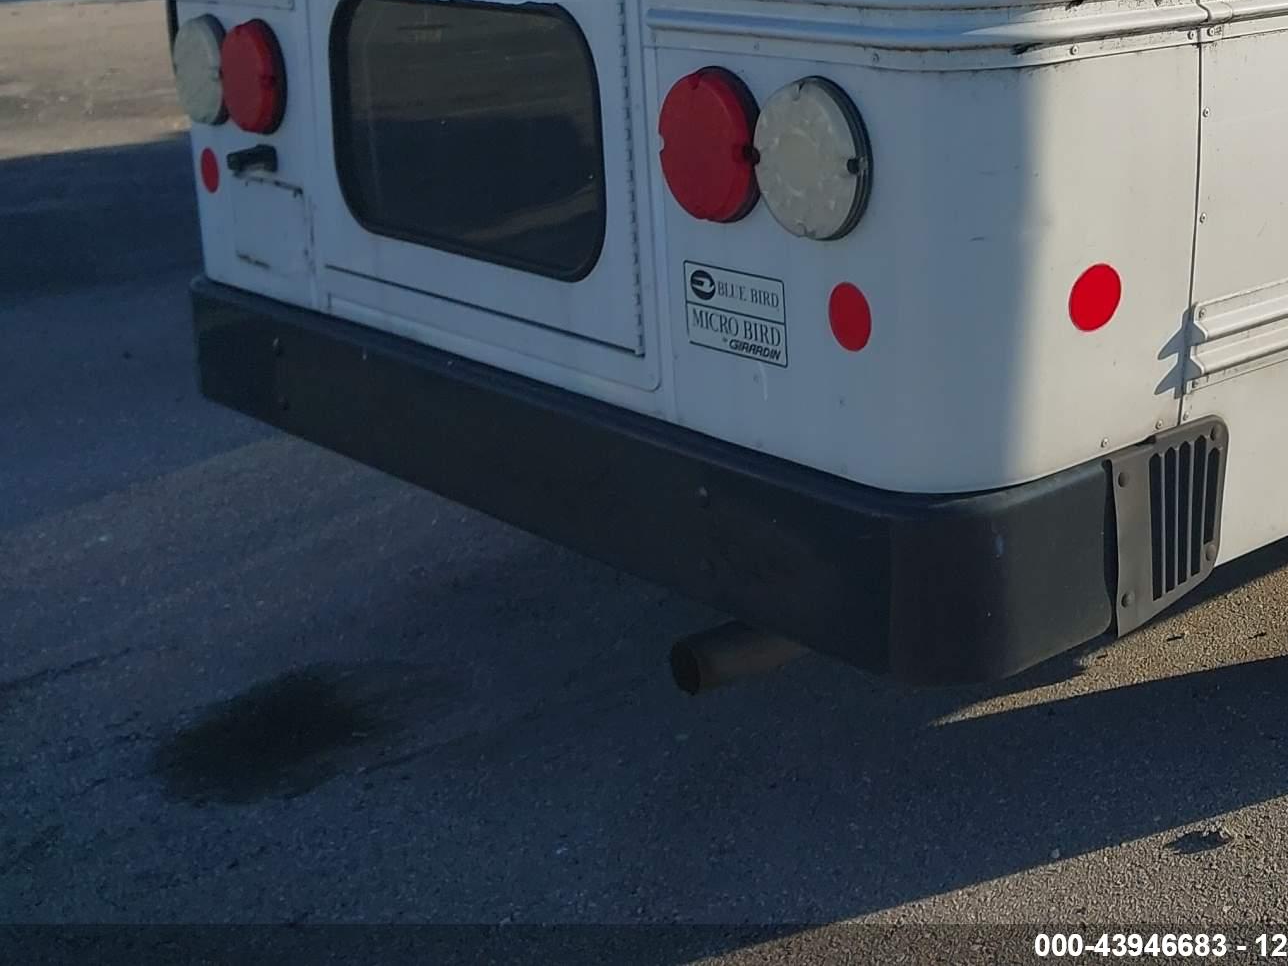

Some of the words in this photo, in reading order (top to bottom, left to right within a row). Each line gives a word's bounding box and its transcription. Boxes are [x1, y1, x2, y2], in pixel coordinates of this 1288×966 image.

[717, 280, 748, 301] BLUE
[751, 287, 779, 308] BIRD
[692, 309, 739, 337] MICRO
[743, 320, 782, 348] BIRD
[729, 339, 781, 360] GIRARDIN
